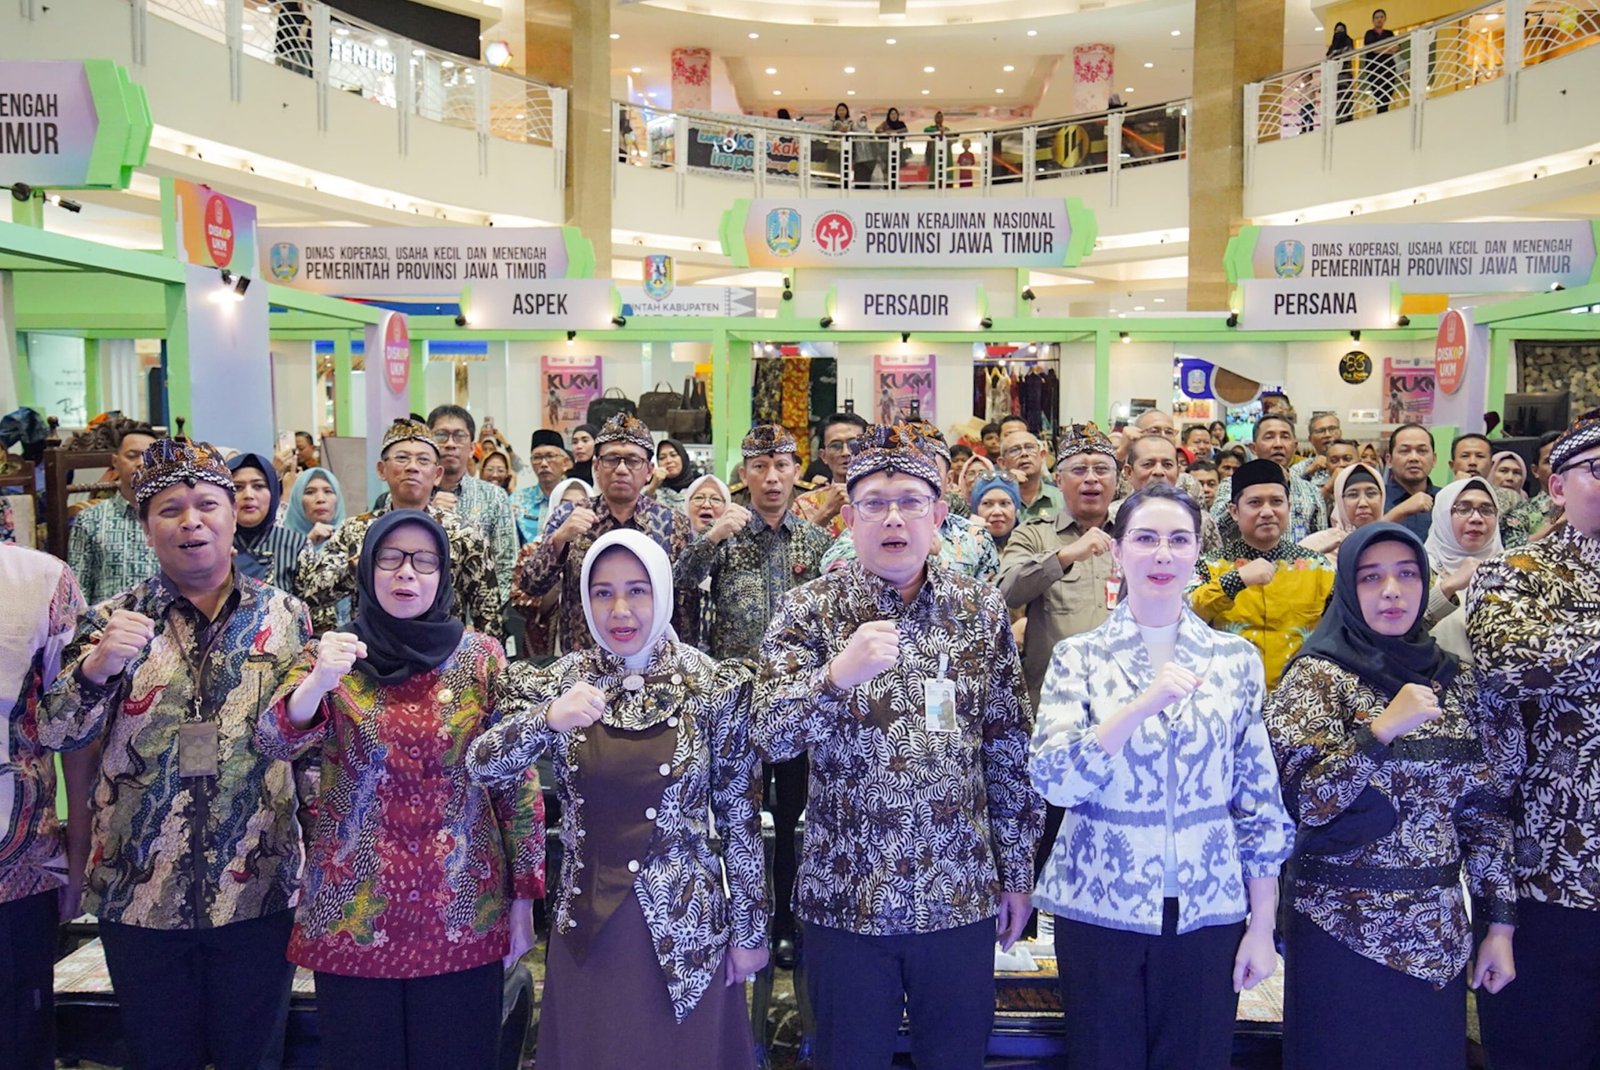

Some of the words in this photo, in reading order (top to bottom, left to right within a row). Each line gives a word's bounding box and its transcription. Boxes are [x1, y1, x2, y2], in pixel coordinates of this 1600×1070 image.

[0, 93, 58, 117] ENGAH
[865, 212, 909, 229] DEWAN
[917, 212, 985, 229] KERAJINAN
[993, 212, 1055, 229] NASIONAL
[866, 232, 940, 254] PROVINSI
[949, 232, 993, 254] JAWA
[1002, 232, 1053, 254] TIMUR
[1311, 243, 1343, 257] DINAS
[1348, 242, 1402, 257] KOPERASI,
[1408, 242, 1443, 256] USAHA
[1449, 241, 1478, 255] KECIL
[1485, 240, 1507, 254] DAN
[1513, 239, 1573, 254] MENENGAH
[305, 246, 335, 260] DINAS
[340, 246, 390, 260] KOPERASI,
[396, 247, 428, 260] USAHA
[434, 247, 461, 260] KECIL
[467, 247, 487, 260] DAN
[493, 247, 546, 260] MENENGAH
[306, 262, 390, 280] PEMERINTAH
[397, 262, 457, 280] PROVINSI
[464, 262, 499, 279] JAWA
[505, 262, 546, 279] TIMUR
[1311, 258, 1400, 277] PEMERINTAH
[1407, 257, 1472, 276] PROVINSI
[1479, 256, 1518, 275] JAWA
[1525, 255, 1571, 274] TIMUR
[512, 293, 568, 315] ASPEK
[663, 303, 719, 311] KABUPATEN
[864, 294, 949, 316] PERSADIR
[1274, 292, 1358, 315] PERSANA
[547, 373, 598, 390] KUKM
[880, 372, 932, 389] KUKM
